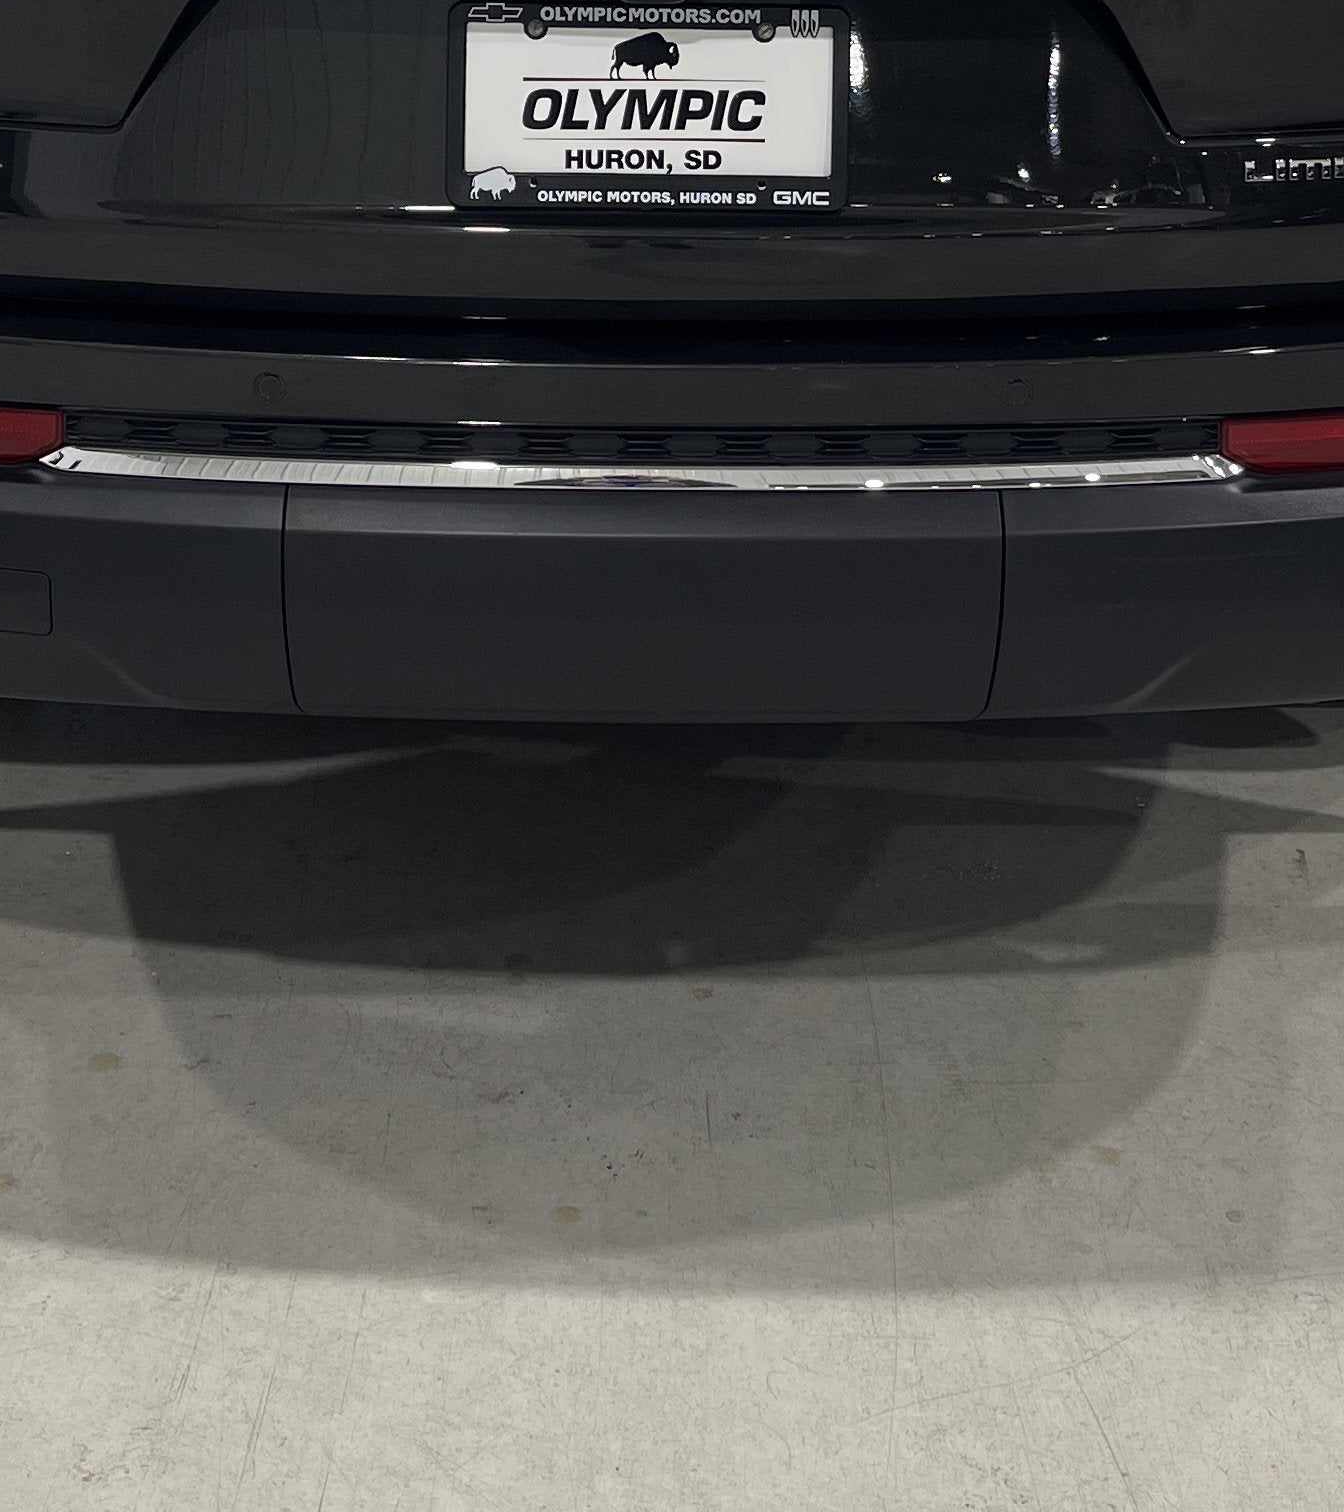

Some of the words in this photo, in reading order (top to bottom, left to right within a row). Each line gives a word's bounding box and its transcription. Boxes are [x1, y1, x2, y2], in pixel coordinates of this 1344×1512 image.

[540, 7, 761, 24] OLYMPICMOTORS.COM
[522, 88, 766, 131] OLYMPIC
[565, 149, 674, 174] HURON,
[684, 149, 722, 170] SD
[537, 189, 603, 204] OLYMPIC
[607, 190, 675, 206] MOTORS,
[679, 190, 731, 205] HURON
[735, 191, 756, 205] SD
[773, 190, 829, 206] GMC
